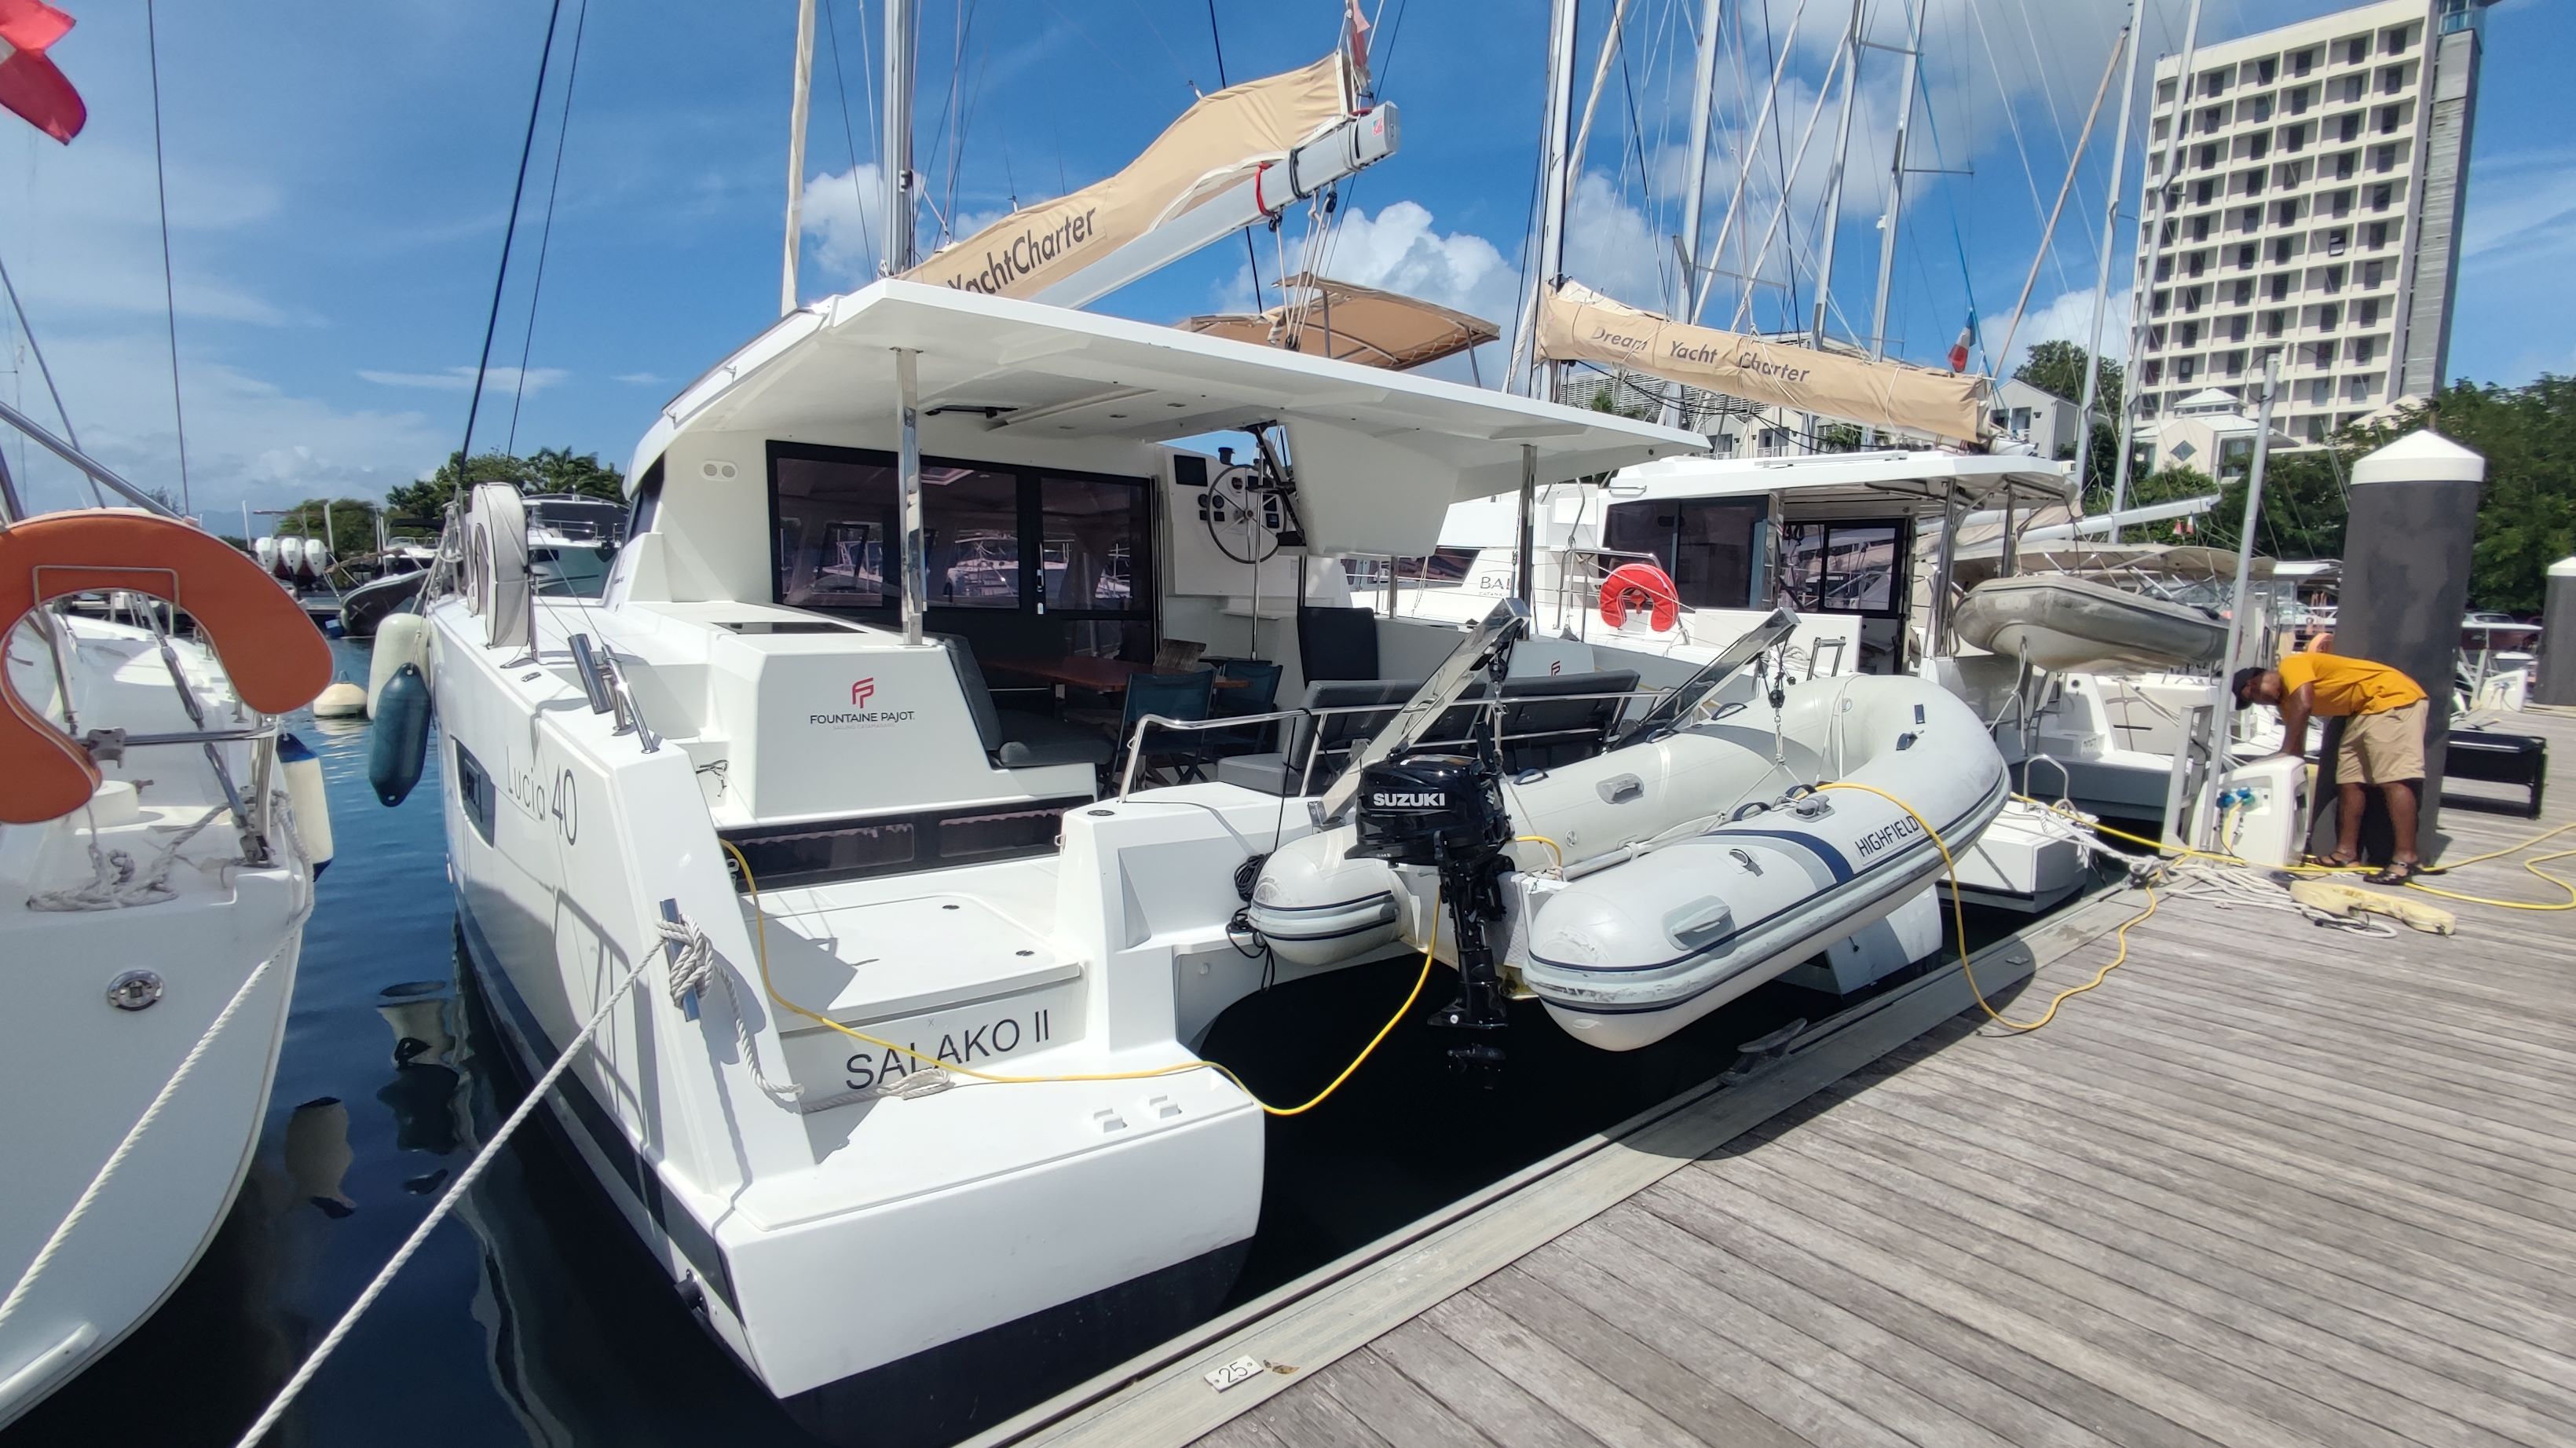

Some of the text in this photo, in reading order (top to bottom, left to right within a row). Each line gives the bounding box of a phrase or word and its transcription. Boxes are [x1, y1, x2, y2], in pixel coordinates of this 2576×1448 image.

[1590, 326, 1811, 382] Dream Yacht Charter
[810, 711, 915, 725] FOUNTAINE PAJOT
[507, 745, 577, 846] Lucia 40
[1373, 792, 1446, 807] SUZUKI
[1854, 815, 1919, 857] HIGHFIELD
[846, 1008, 1049, 1090] SALAKO II
[1218, 1361, 1248, 1383] 25
